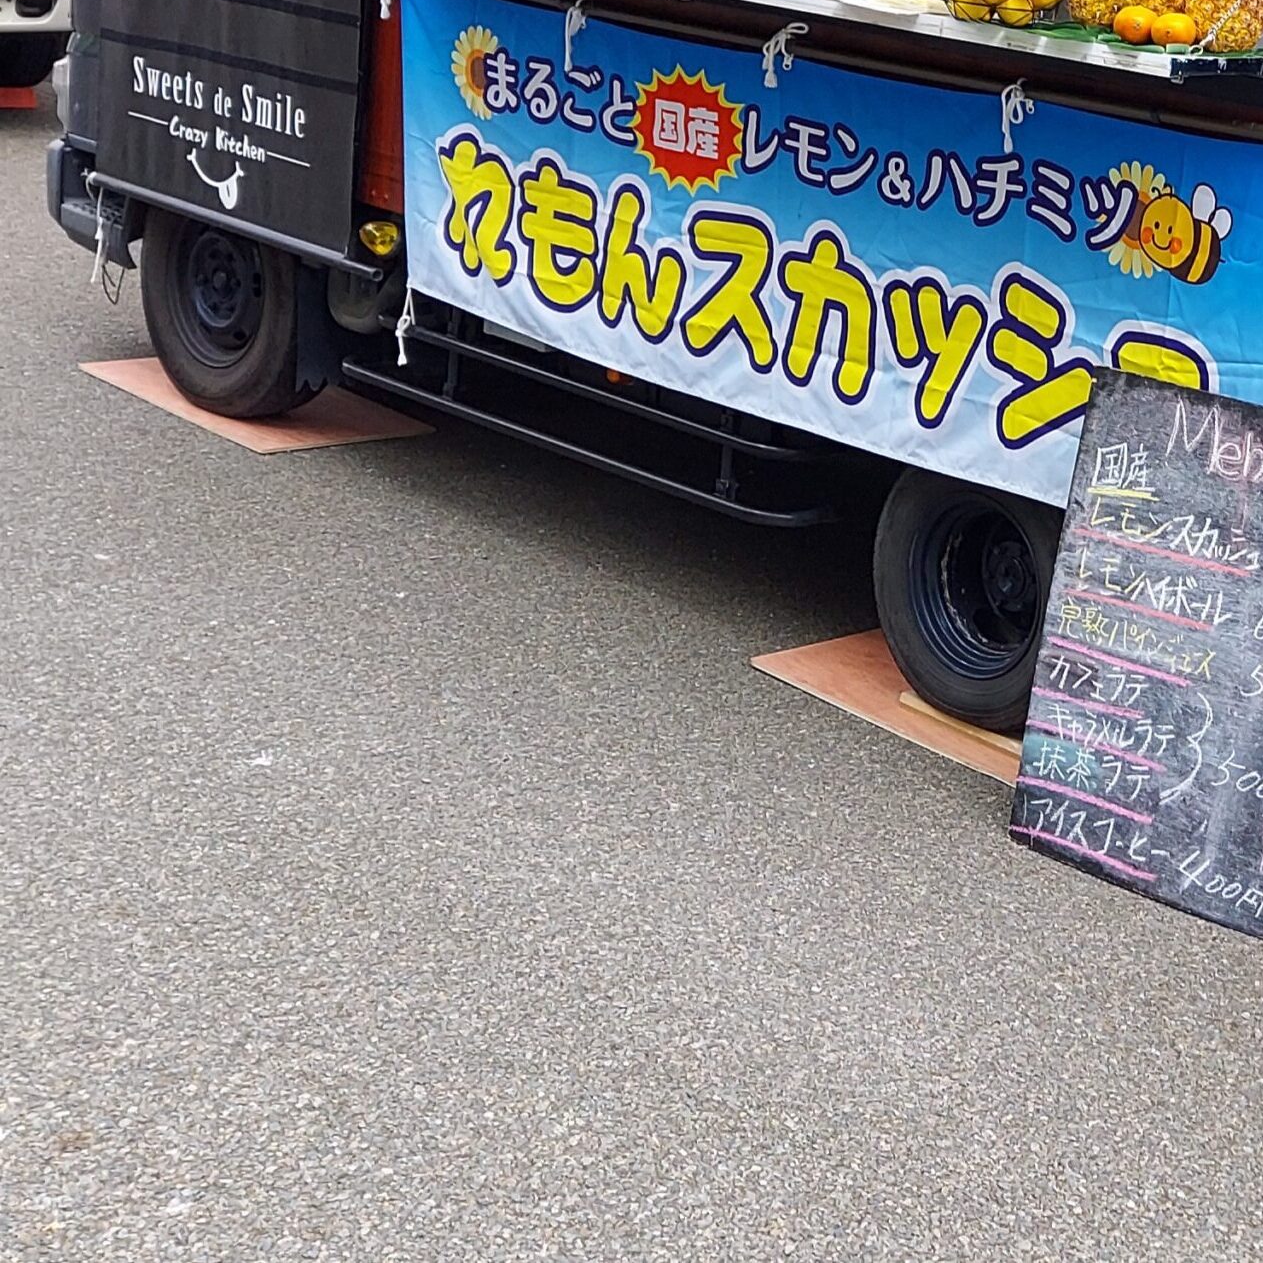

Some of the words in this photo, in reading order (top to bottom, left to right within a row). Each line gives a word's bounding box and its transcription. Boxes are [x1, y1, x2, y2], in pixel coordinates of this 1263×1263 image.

[132, 55, 204, 110] Sweets
[213, 86, 232, 118] de
[241, 83, 306, 138] Smile
[169, 115, 209, 148] Crazy
[215, 126, 265, 162] Kitchen
[1092, 443, 1152, 489] 国産
[1049, 655, 1150, 707] カフェラテ
[1047, 702, 1176, 757] キャラメルラテ
[1032, 741, 1150, 801] 抹茶ラテ
